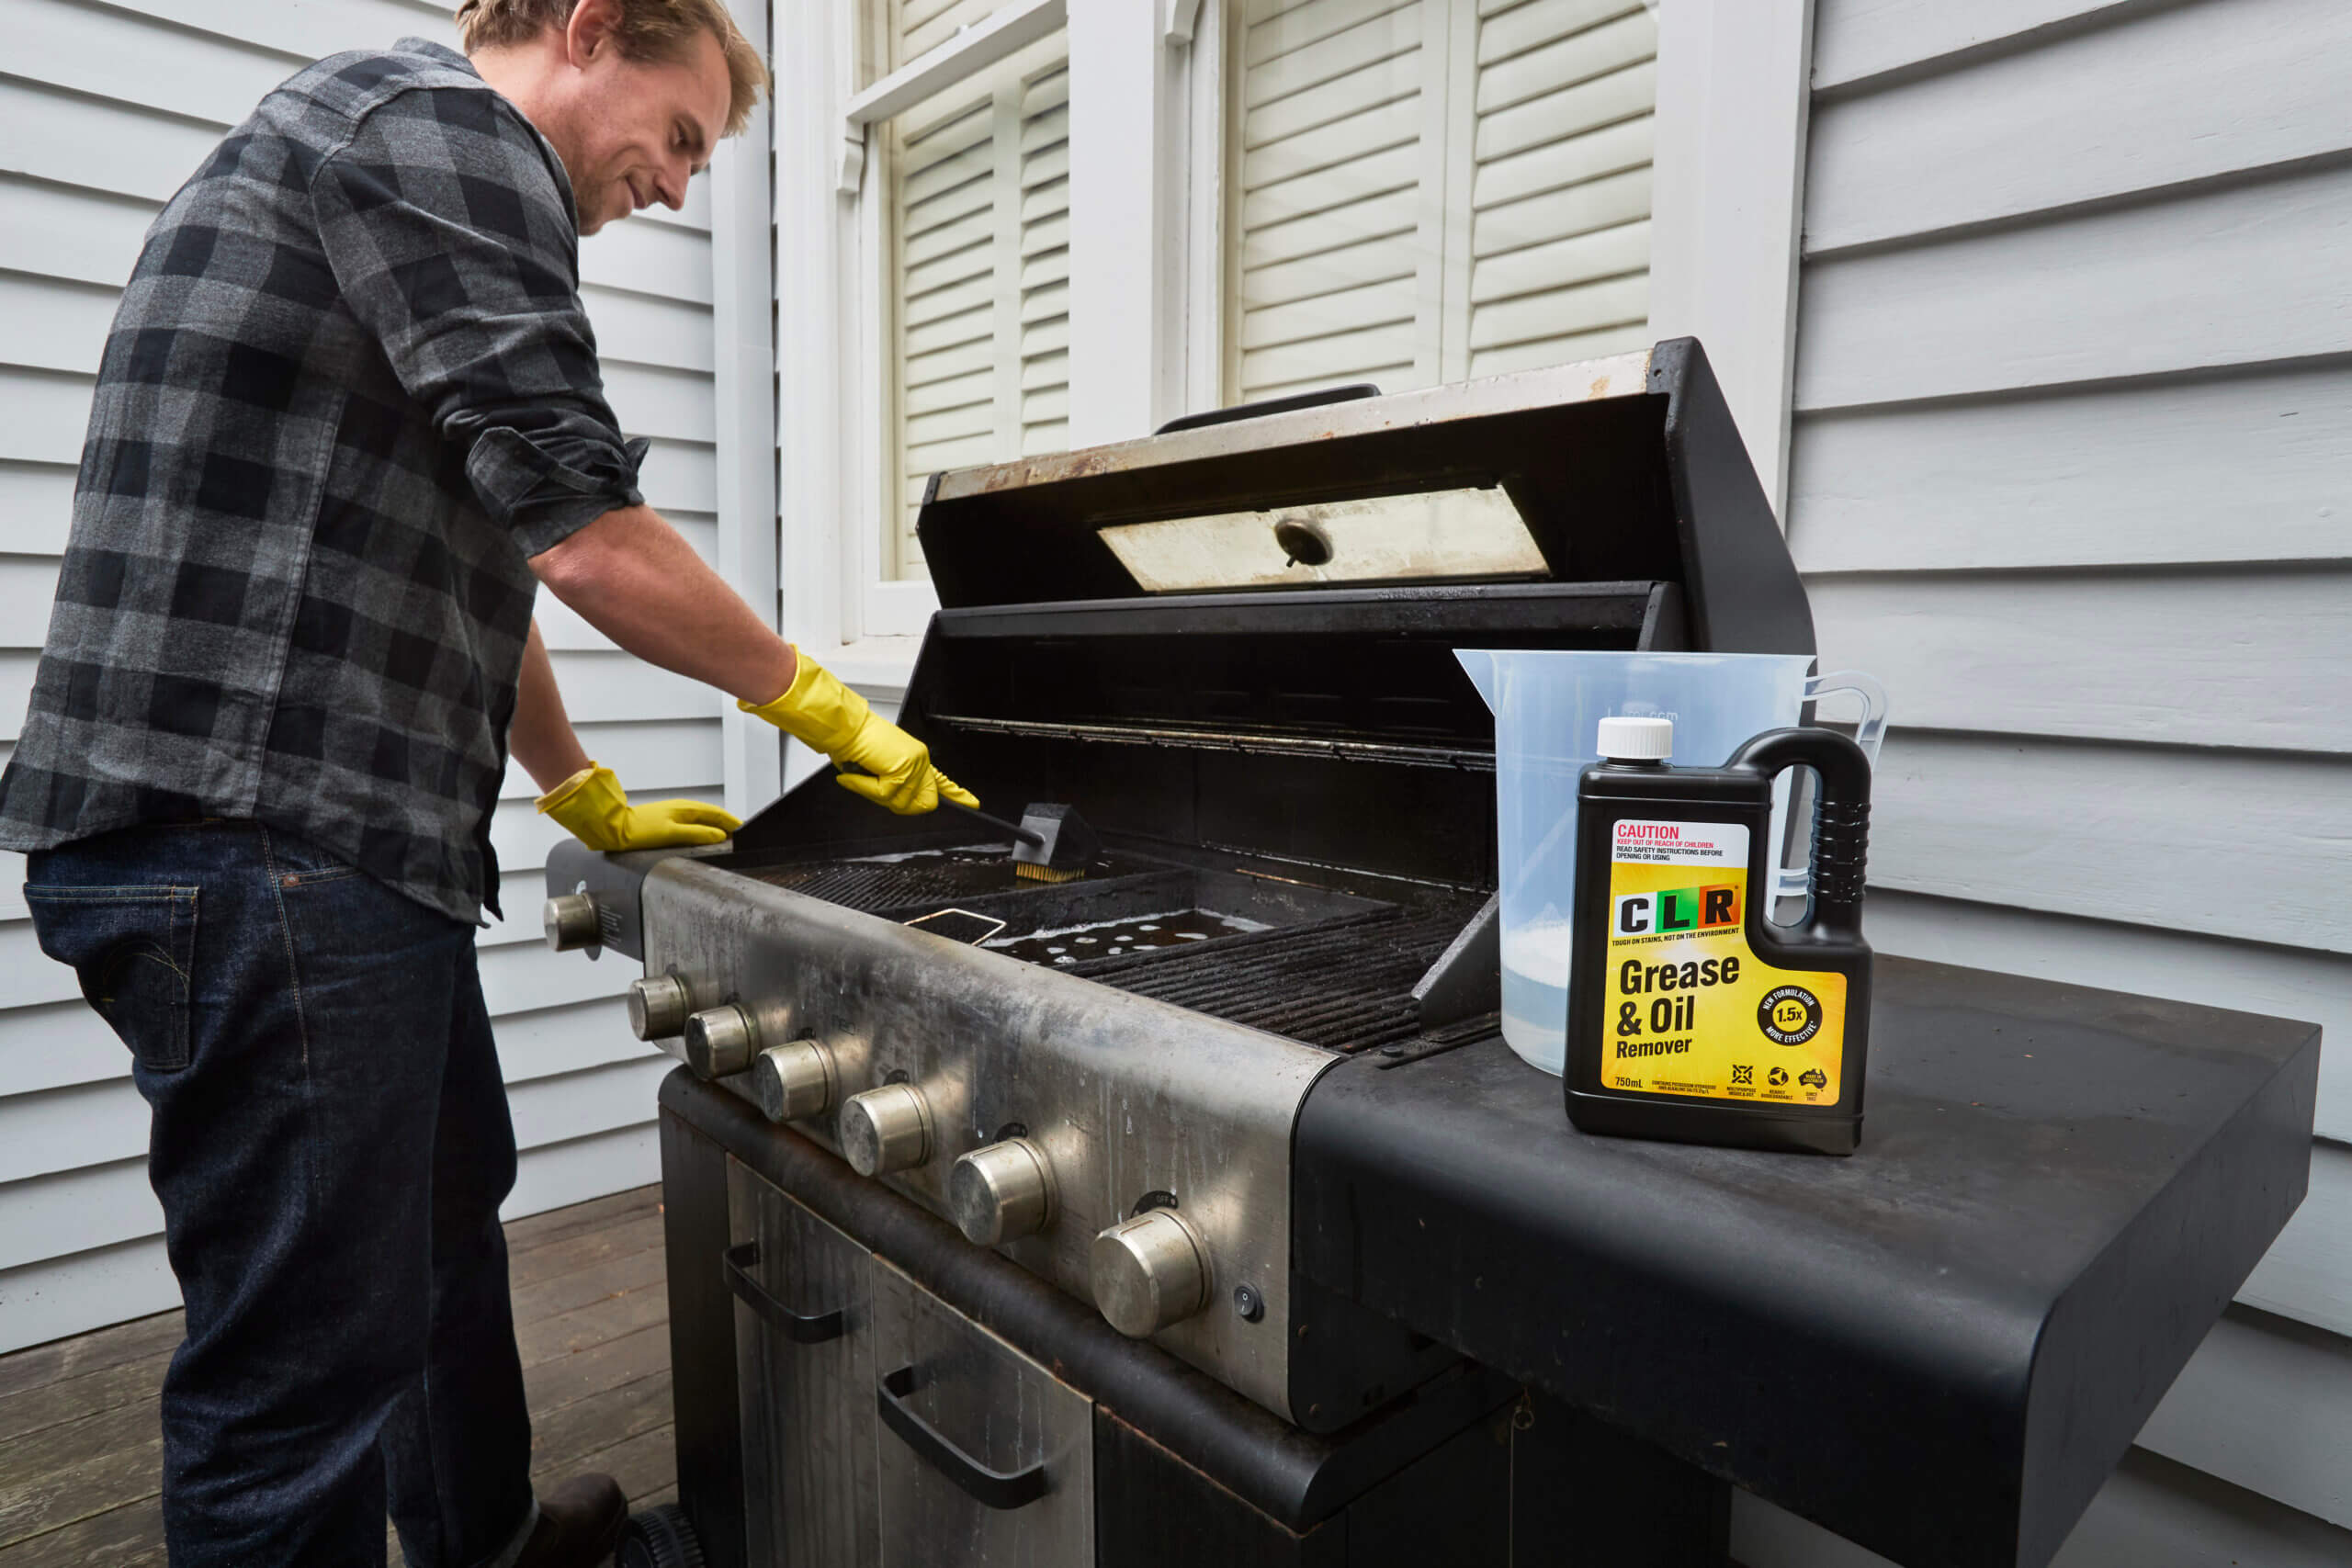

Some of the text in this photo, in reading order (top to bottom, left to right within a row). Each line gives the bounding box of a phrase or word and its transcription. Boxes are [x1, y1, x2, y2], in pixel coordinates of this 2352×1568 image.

[1617, 824, 1679, 840] CAUTION
[1620, 889, 1734, 933] CLR
[1641, 936, 1663, 944] STAINS,
[1698, 927, 1739, 938] ENVIRONMENT
[1620, 956, 1740, 995] Grease
[1763, 988, 1815, 1010] NEW FORMULATION
[1616, 995, 1695, 1036] & Oil
[1777, 1007, 1803, 1022] 1.5x
[1766, 1026, 1783, 1042] MORE
[1616, 1038, 1692, 1059] Remover
[1615, 1076, 1643, 1089] 750mL
